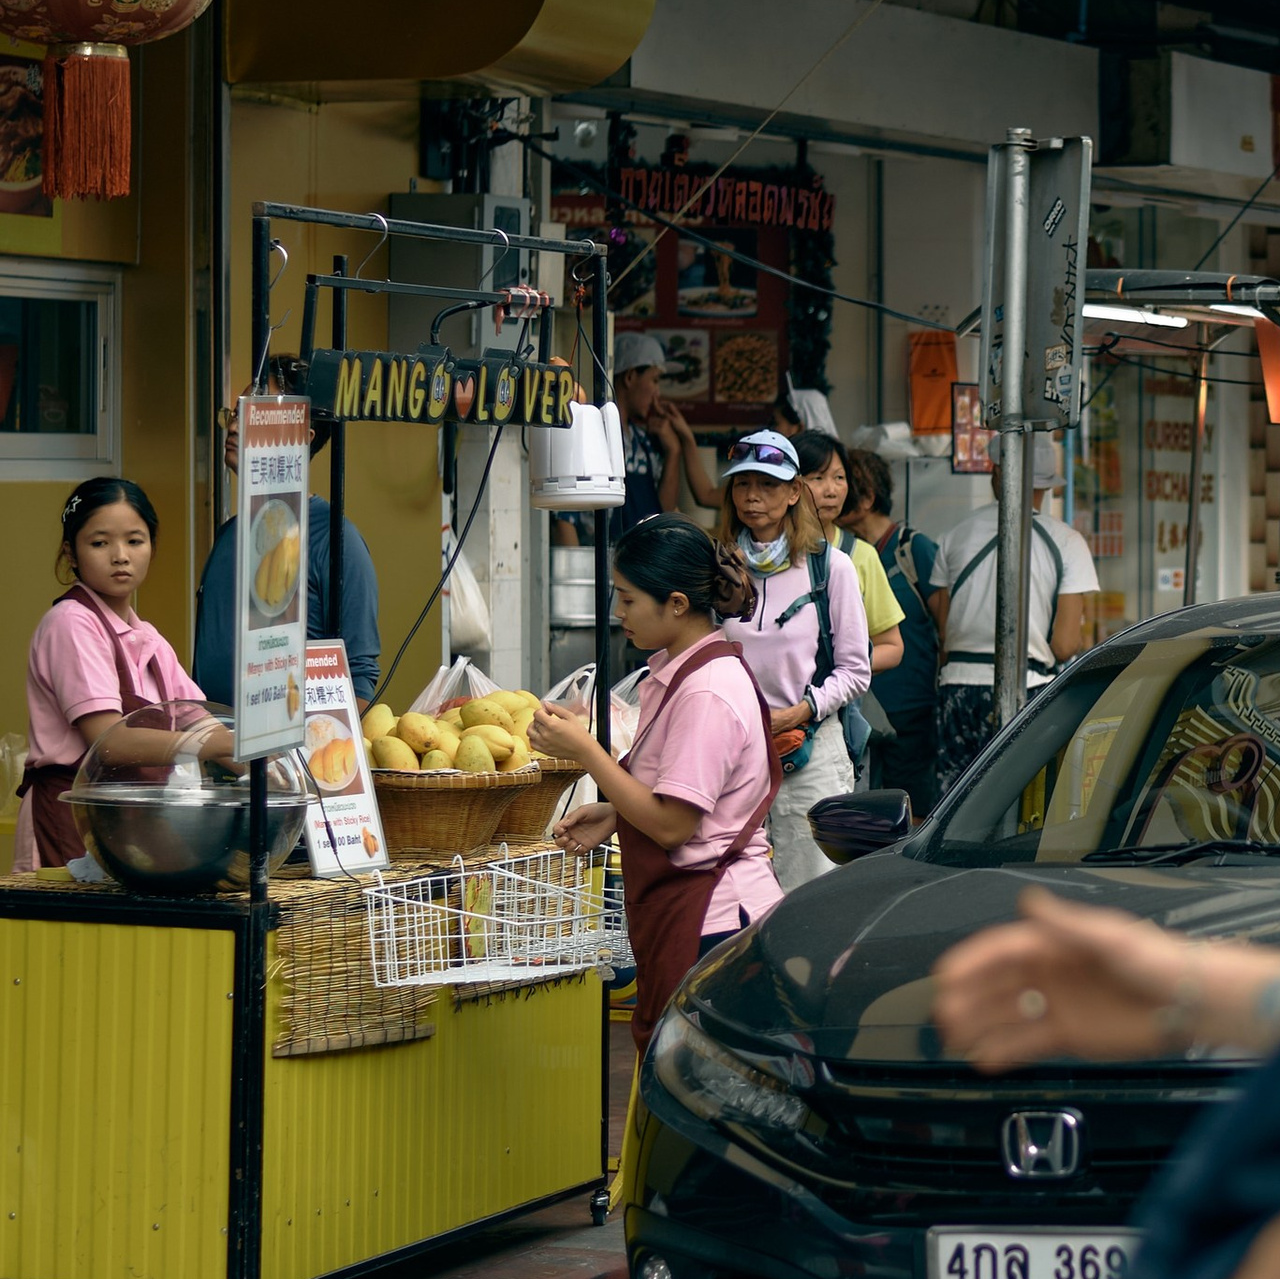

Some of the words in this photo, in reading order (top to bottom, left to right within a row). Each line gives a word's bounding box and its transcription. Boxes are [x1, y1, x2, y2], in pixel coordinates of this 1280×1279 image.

[334, 358, 451, 420] MANGO
[476, 360, 575, 425] LOVER
[250, 404, 306, 426] Recommended
[273, 684, 287, 701] Baht
[305, 684, 347, 706] 和糯米饭
[346, 834, 361, 845] Baht
